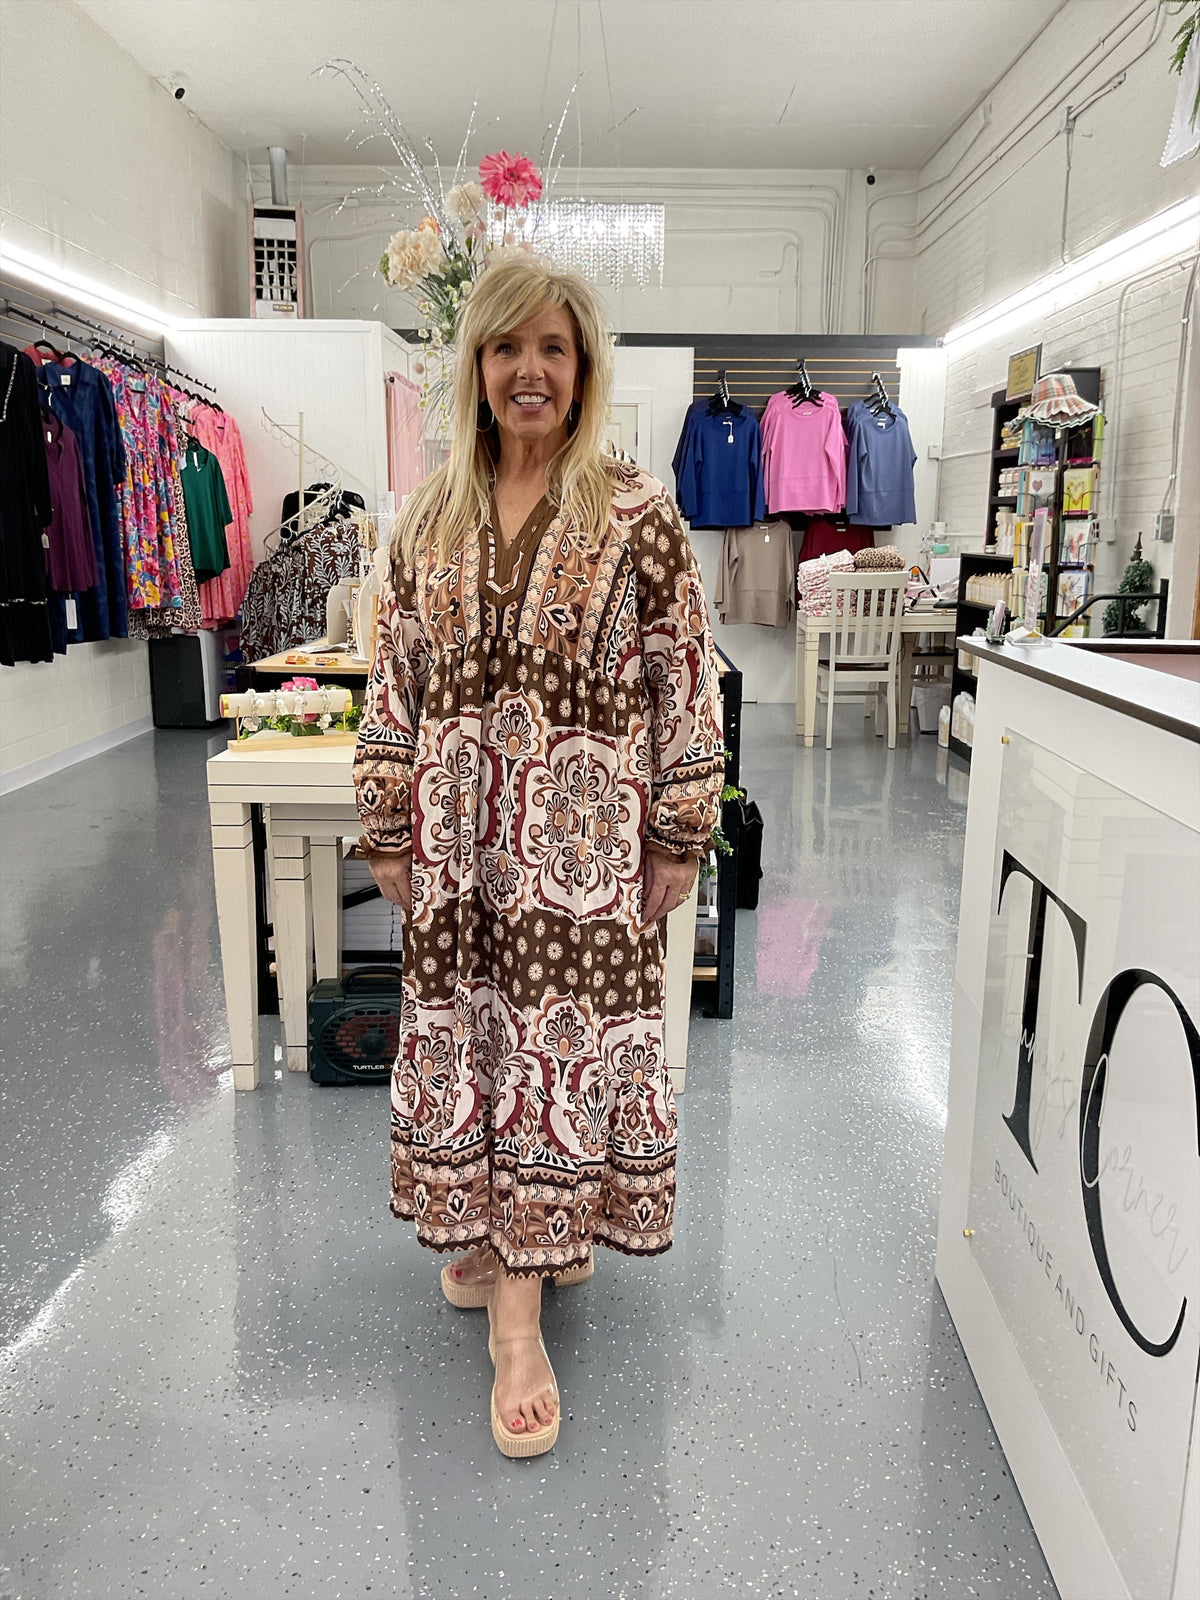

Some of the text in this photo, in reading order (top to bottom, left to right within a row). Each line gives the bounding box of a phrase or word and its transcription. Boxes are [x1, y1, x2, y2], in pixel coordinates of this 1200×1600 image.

[993, 1159, 1138, 1433] BOUTIQUE AND GIFTS
